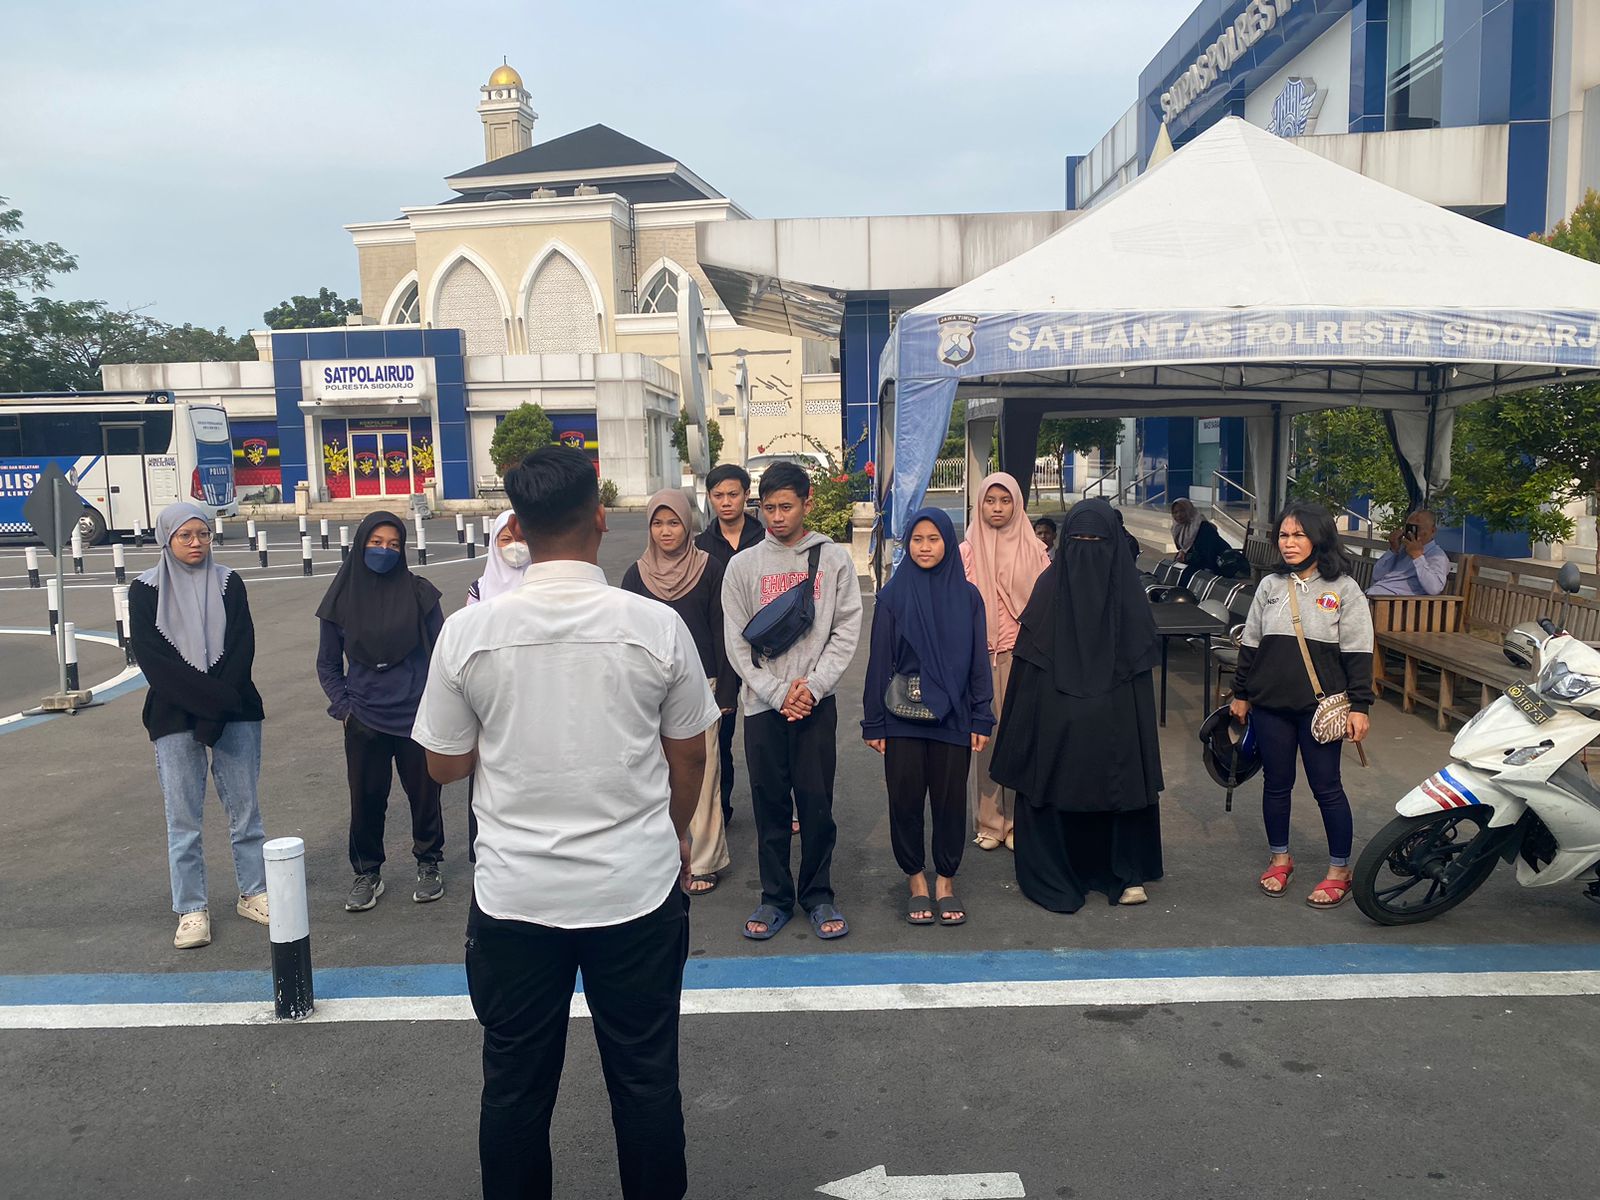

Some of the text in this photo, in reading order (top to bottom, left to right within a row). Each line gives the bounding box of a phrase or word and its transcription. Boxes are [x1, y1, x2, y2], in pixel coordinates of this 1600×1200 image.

[1008, 321, 1598, 351] SATLANTAS POLRESTA SIDOARJ
[324, 365, 414, 384] SATPOLAIRUD
[325, 382, 414, 391] POLRESTA SIDOARJO
[209, 467, 227, 475] POLISI
